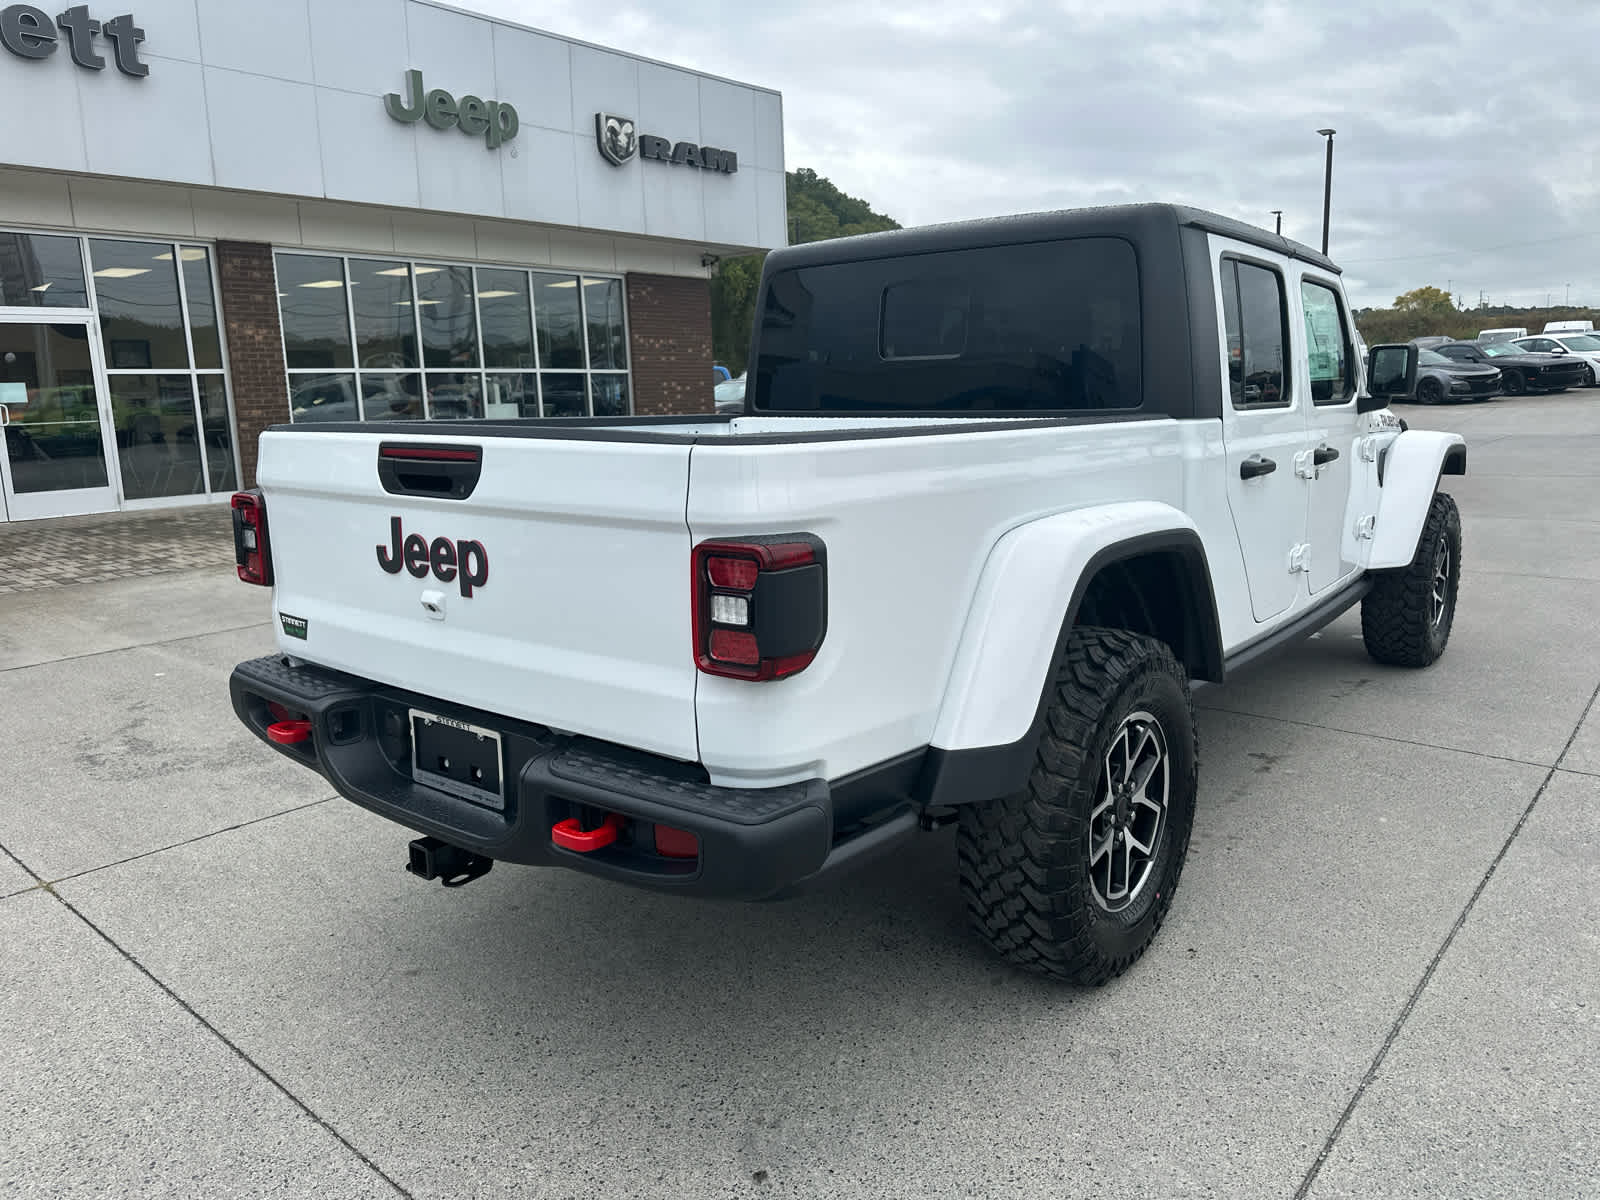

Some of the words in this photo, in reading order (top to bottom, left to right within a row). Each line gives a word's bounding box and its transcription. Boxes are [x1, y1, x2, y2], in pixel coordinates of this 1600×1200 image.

[0, 4, 150, 78] ett
[383, 69, 519, 150] Jeep
[638, 134, 738, 174] RAM
[376, 515, 489, 598] Jeep
